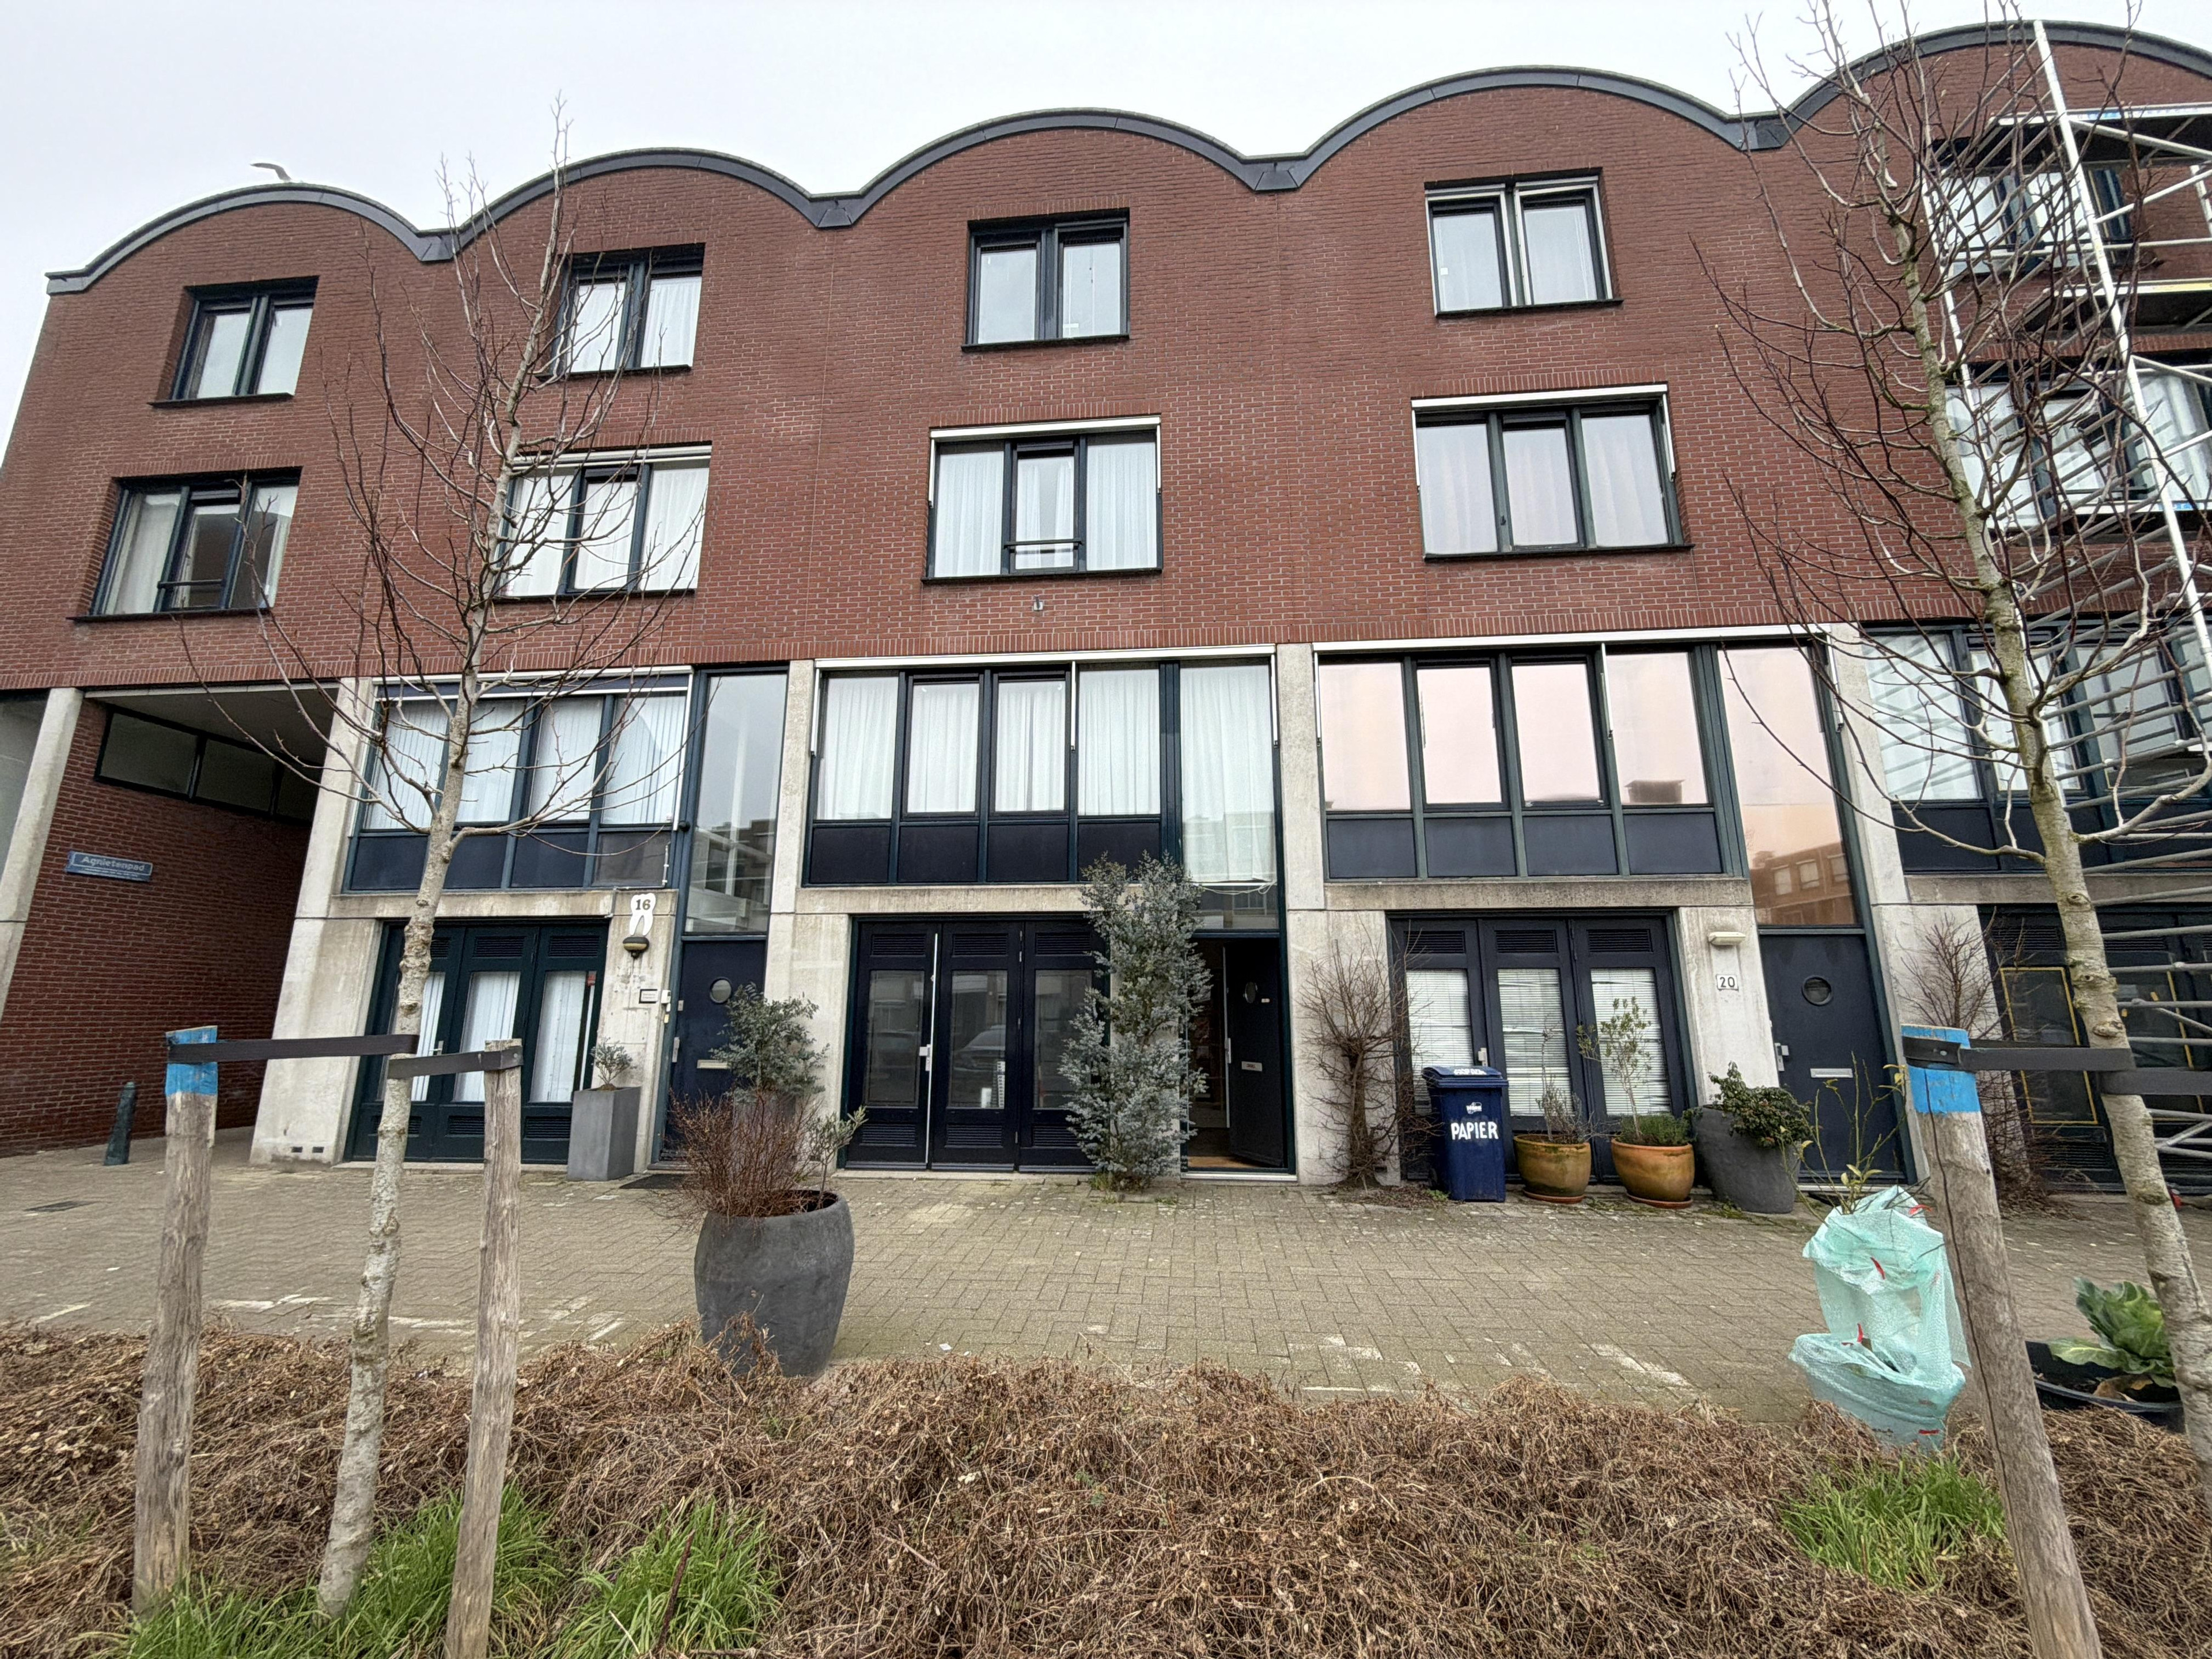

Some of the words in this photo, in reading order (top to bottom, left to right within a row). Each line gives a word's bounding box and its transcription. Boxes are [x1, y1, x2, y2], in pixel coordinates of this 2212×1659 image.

[635, 899, 651, 910] 16
[1719, 976, 1735, 988] 20
[1450, 1121, 1499, 1140] PAPIER
